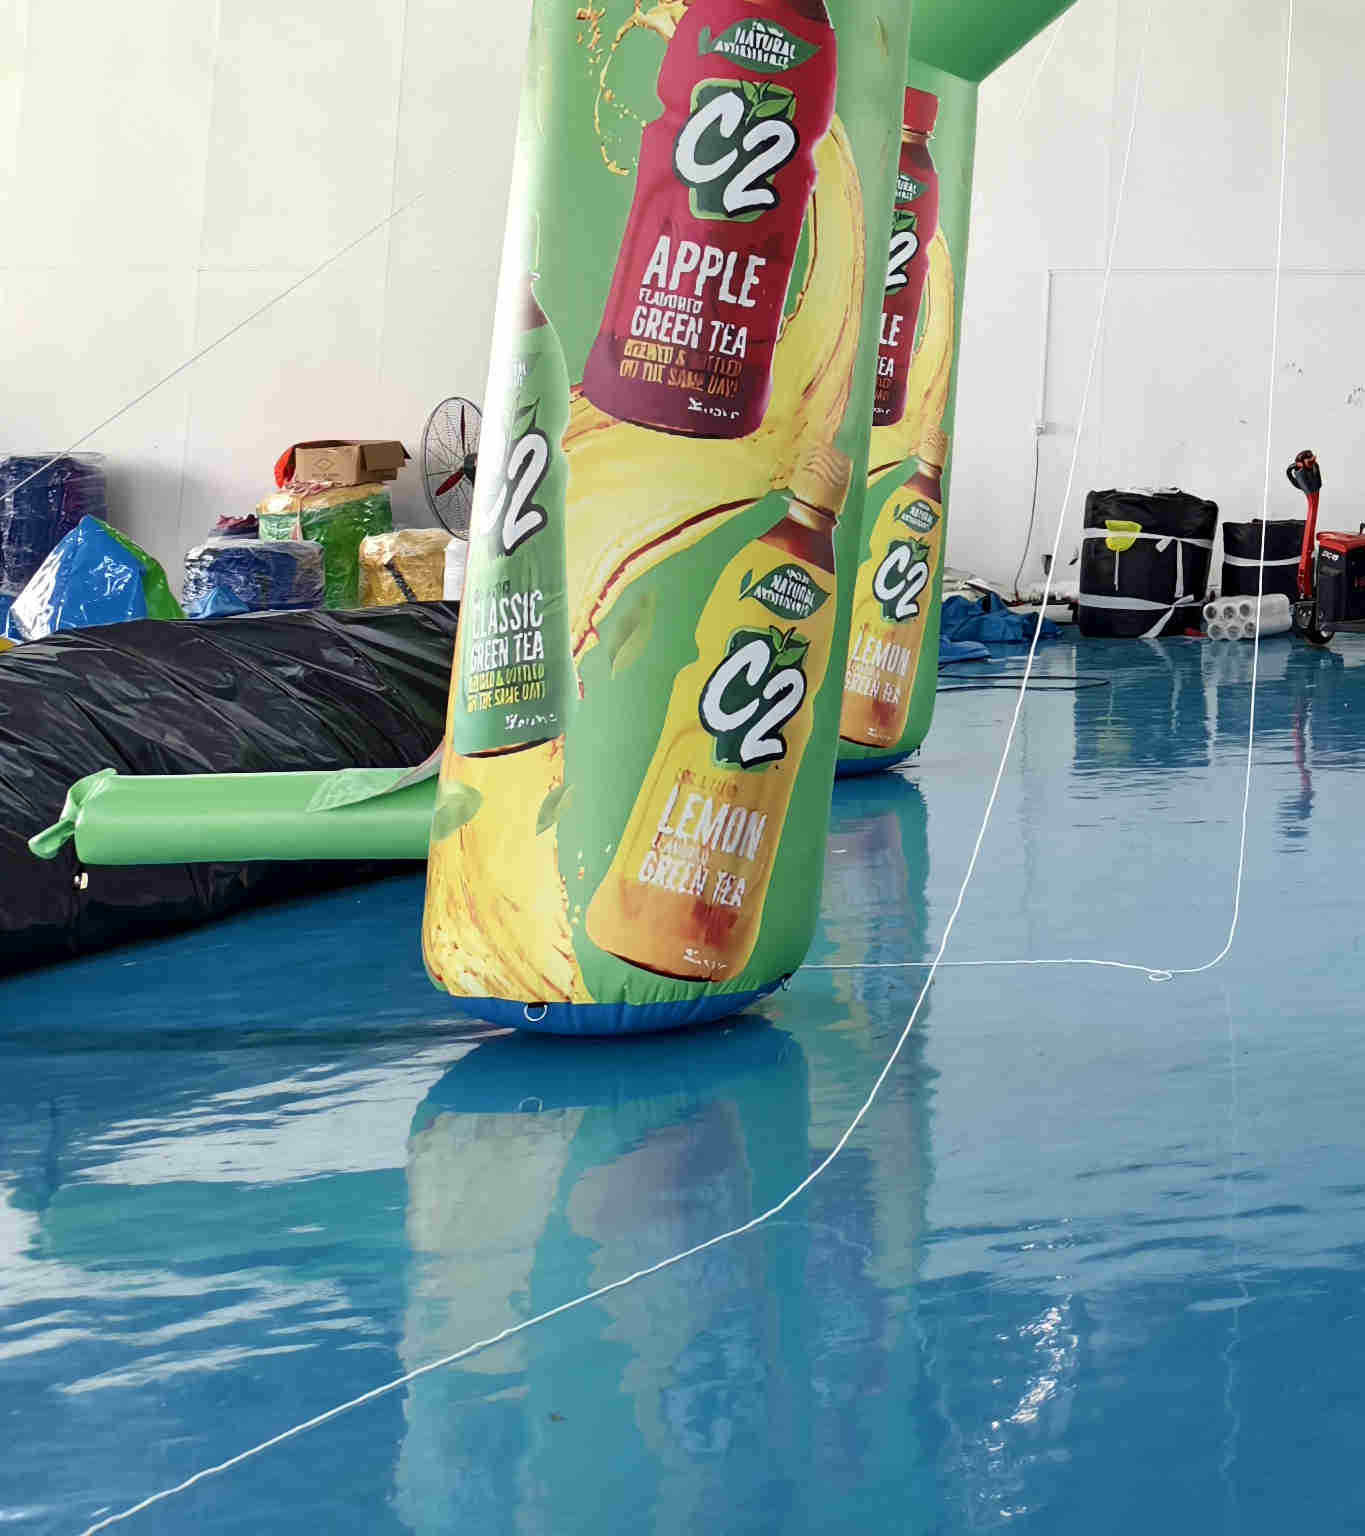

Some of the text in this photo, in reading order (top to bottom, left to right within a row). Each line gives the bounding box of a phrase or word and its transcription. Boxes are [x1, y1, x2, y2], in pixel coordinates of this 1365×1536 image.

[675, 91, 796, 213] C2
[642, 234, 767, 308] APPLE
[886, 231, 917, 287] 2
[630, 305, 749, 359] GREEN TEA
[472, 589, 544, 639] CLASSIC
[875, 545, 928, 618] C2
[471, 630, 545, 674] GREEN TEA
[702, 639, 806, 763] C2
[658, 782, 768, 862] LEMON
[637, 850, 709, 897] GREEN
[711, 871, 747, 908] TEA
